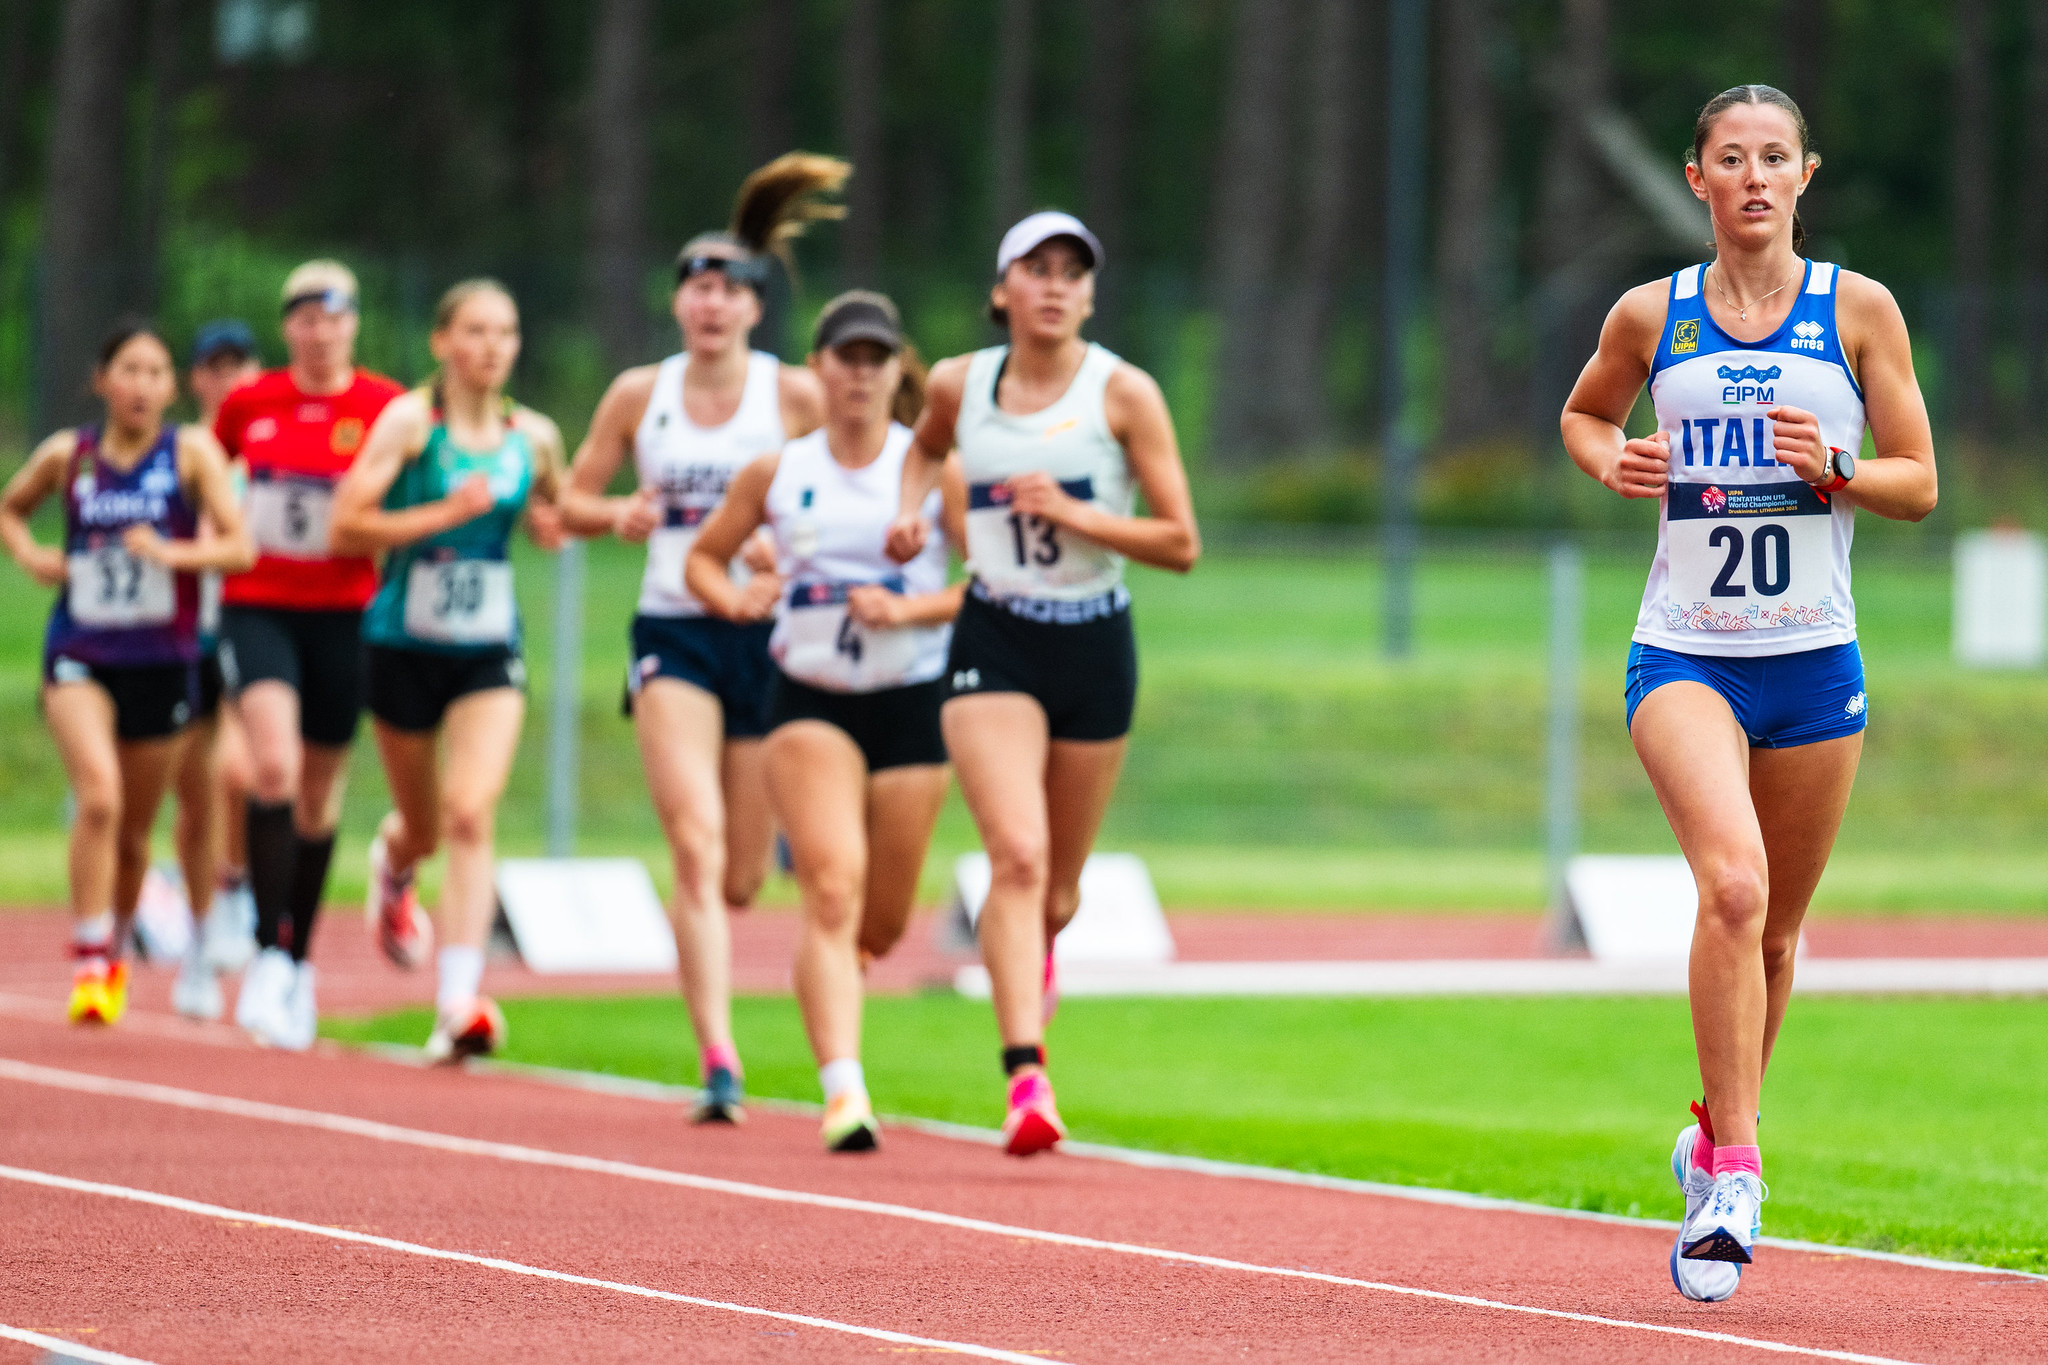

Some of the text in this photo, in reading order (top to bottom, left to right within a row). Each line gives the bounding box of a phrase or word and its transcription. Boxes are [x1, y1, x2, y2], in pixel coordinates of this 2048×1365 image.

[1674, 342, 1696, 350] UIPM
[1722, 386, 1774, 401] FIPM
[1681, 417, 1792, 467] ITAL
[1749, 499, 1798, 508] Championships
[1007, 511, 1060, 567] 13
[1708, 524, 1791, 597] 20
[836, 613, 864, 663] 4
